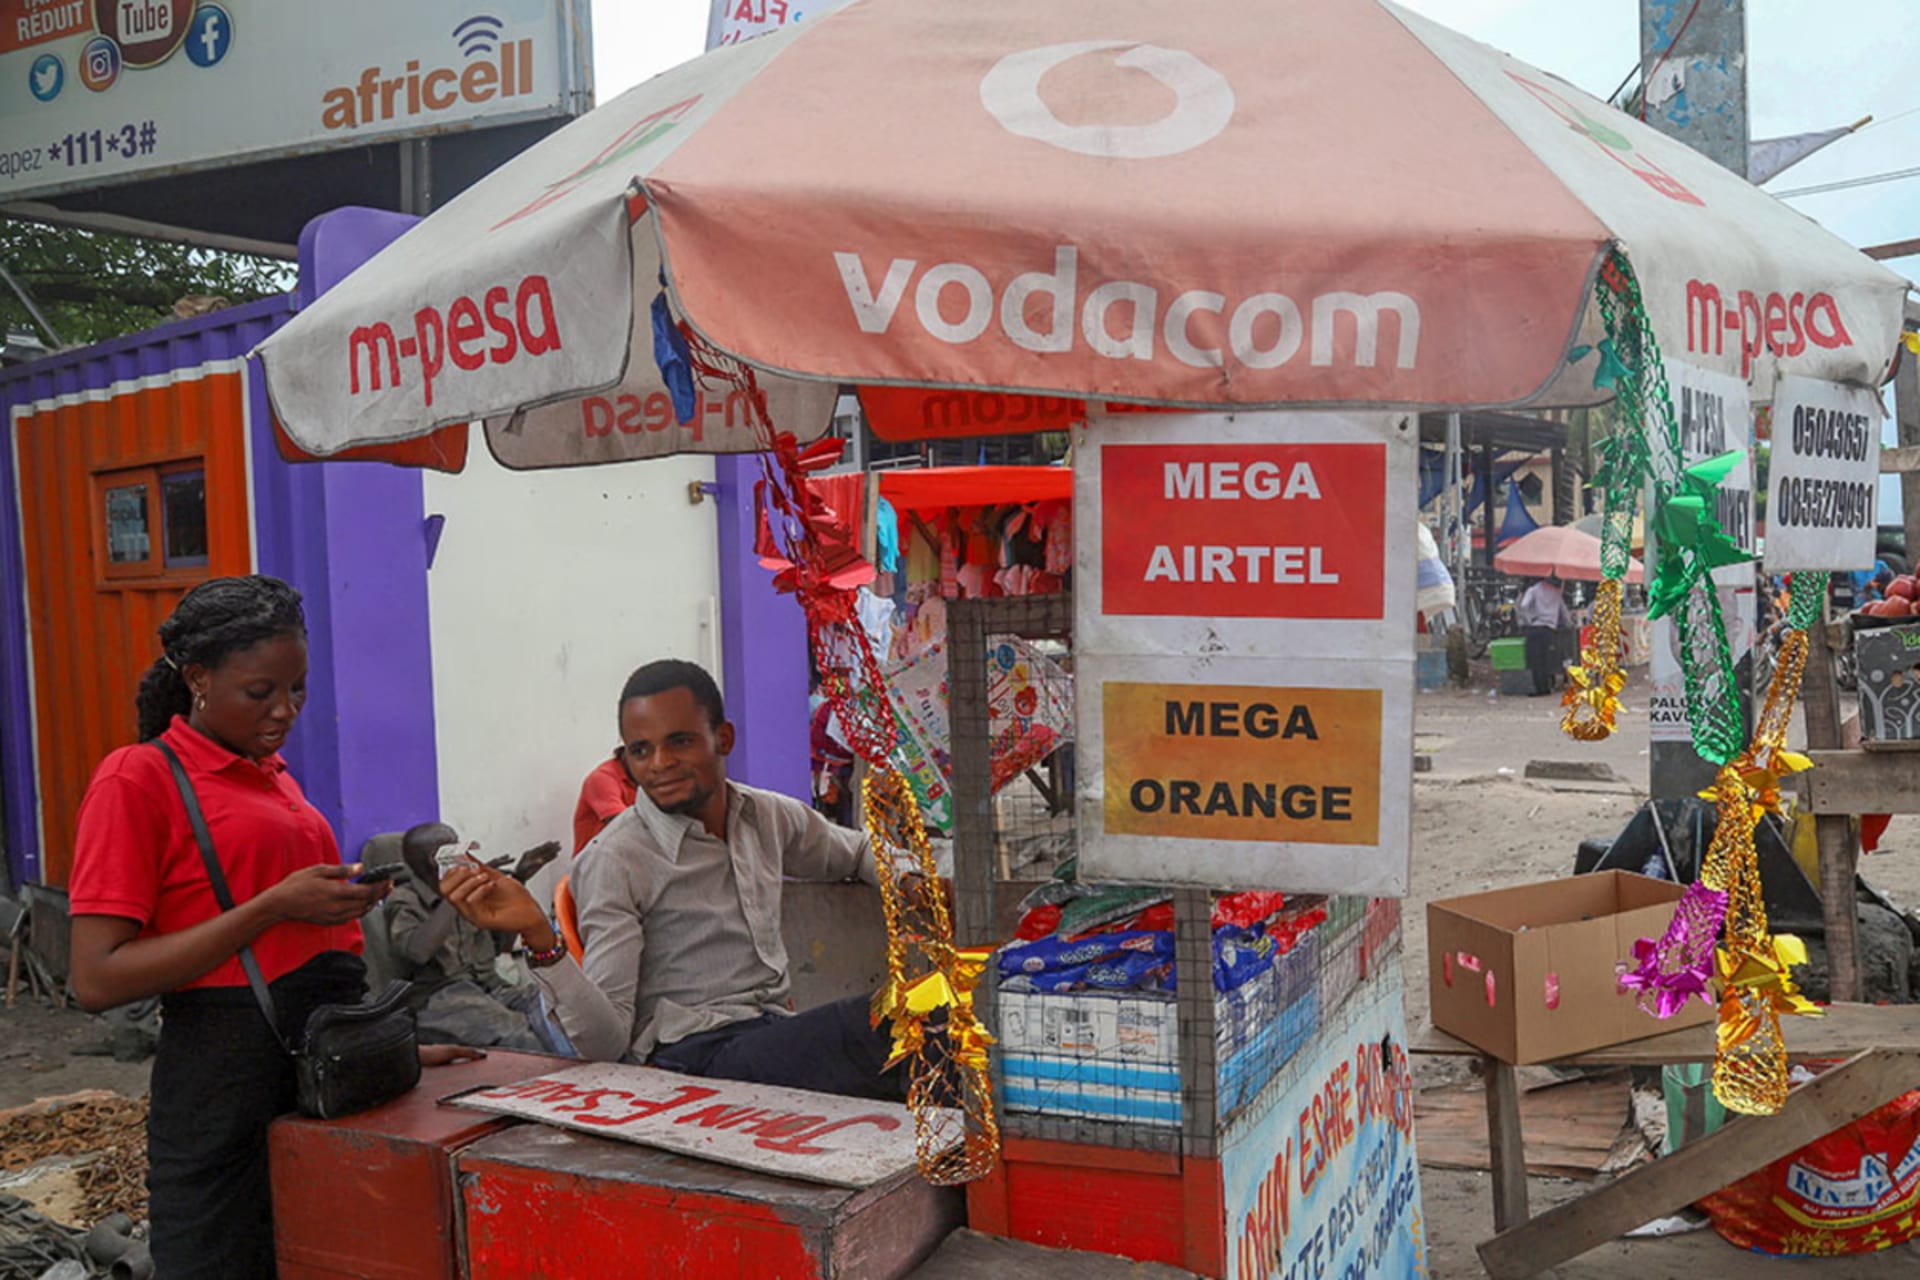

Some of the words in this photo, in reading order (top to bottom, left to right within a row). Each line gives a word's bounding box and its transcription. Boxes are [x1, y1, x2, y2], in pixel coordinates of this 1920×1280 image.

[16, 1, 84, 41] RÉDUIT
[122, 2, 168, 36] Tube
[321, 39, 533, 130] africell
[0, 148, 42, 179] apez
[833, 245, 1421, 369] vodacom
[1686, 278, 1854, 380] m-pesa
[349, 274, 562, 406] m-pesa
[1792, 404, 1869, 461] 05043657
[1163, 461, 1321, 499] MEGA
[1778, 475, 1873, 529] 0855279091
[1144, 545, 1339, 583] AIRTEL
[1165, 701, 1319, 740] MEGA
[1130, 779, 1352, 821] ORANGE
[674, 1104, 902, 1155] JOHN
